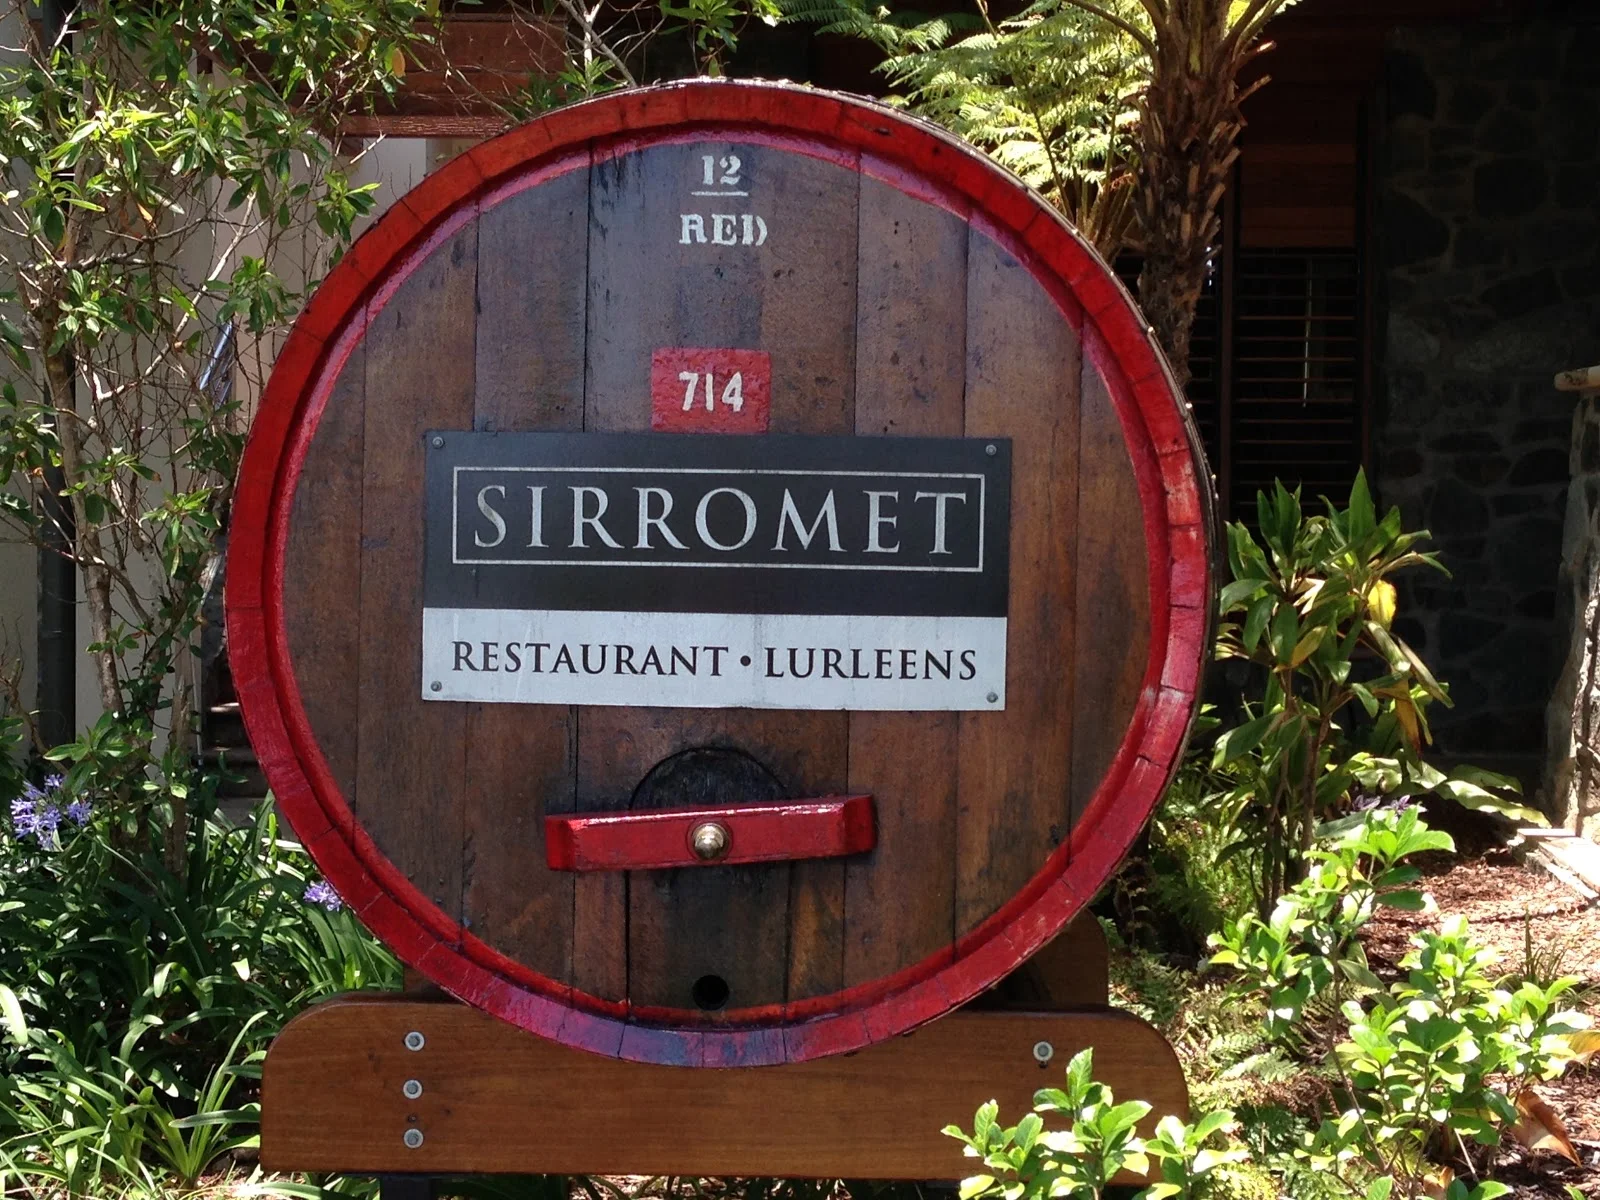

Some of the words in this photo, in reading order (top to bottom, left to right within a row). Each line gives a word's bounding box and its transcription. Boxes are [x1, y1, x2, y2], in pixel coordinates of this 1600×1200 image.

[701, 155, 741, 186] 12
[679, 213, 768, 247] RED
[678, 371, 745, 413] 714
[473, 483, 967, 555] SIRROMET
[451, 640, 729, 679] RESTAURANT
[764, 646, 977, 681] LURLEENS
